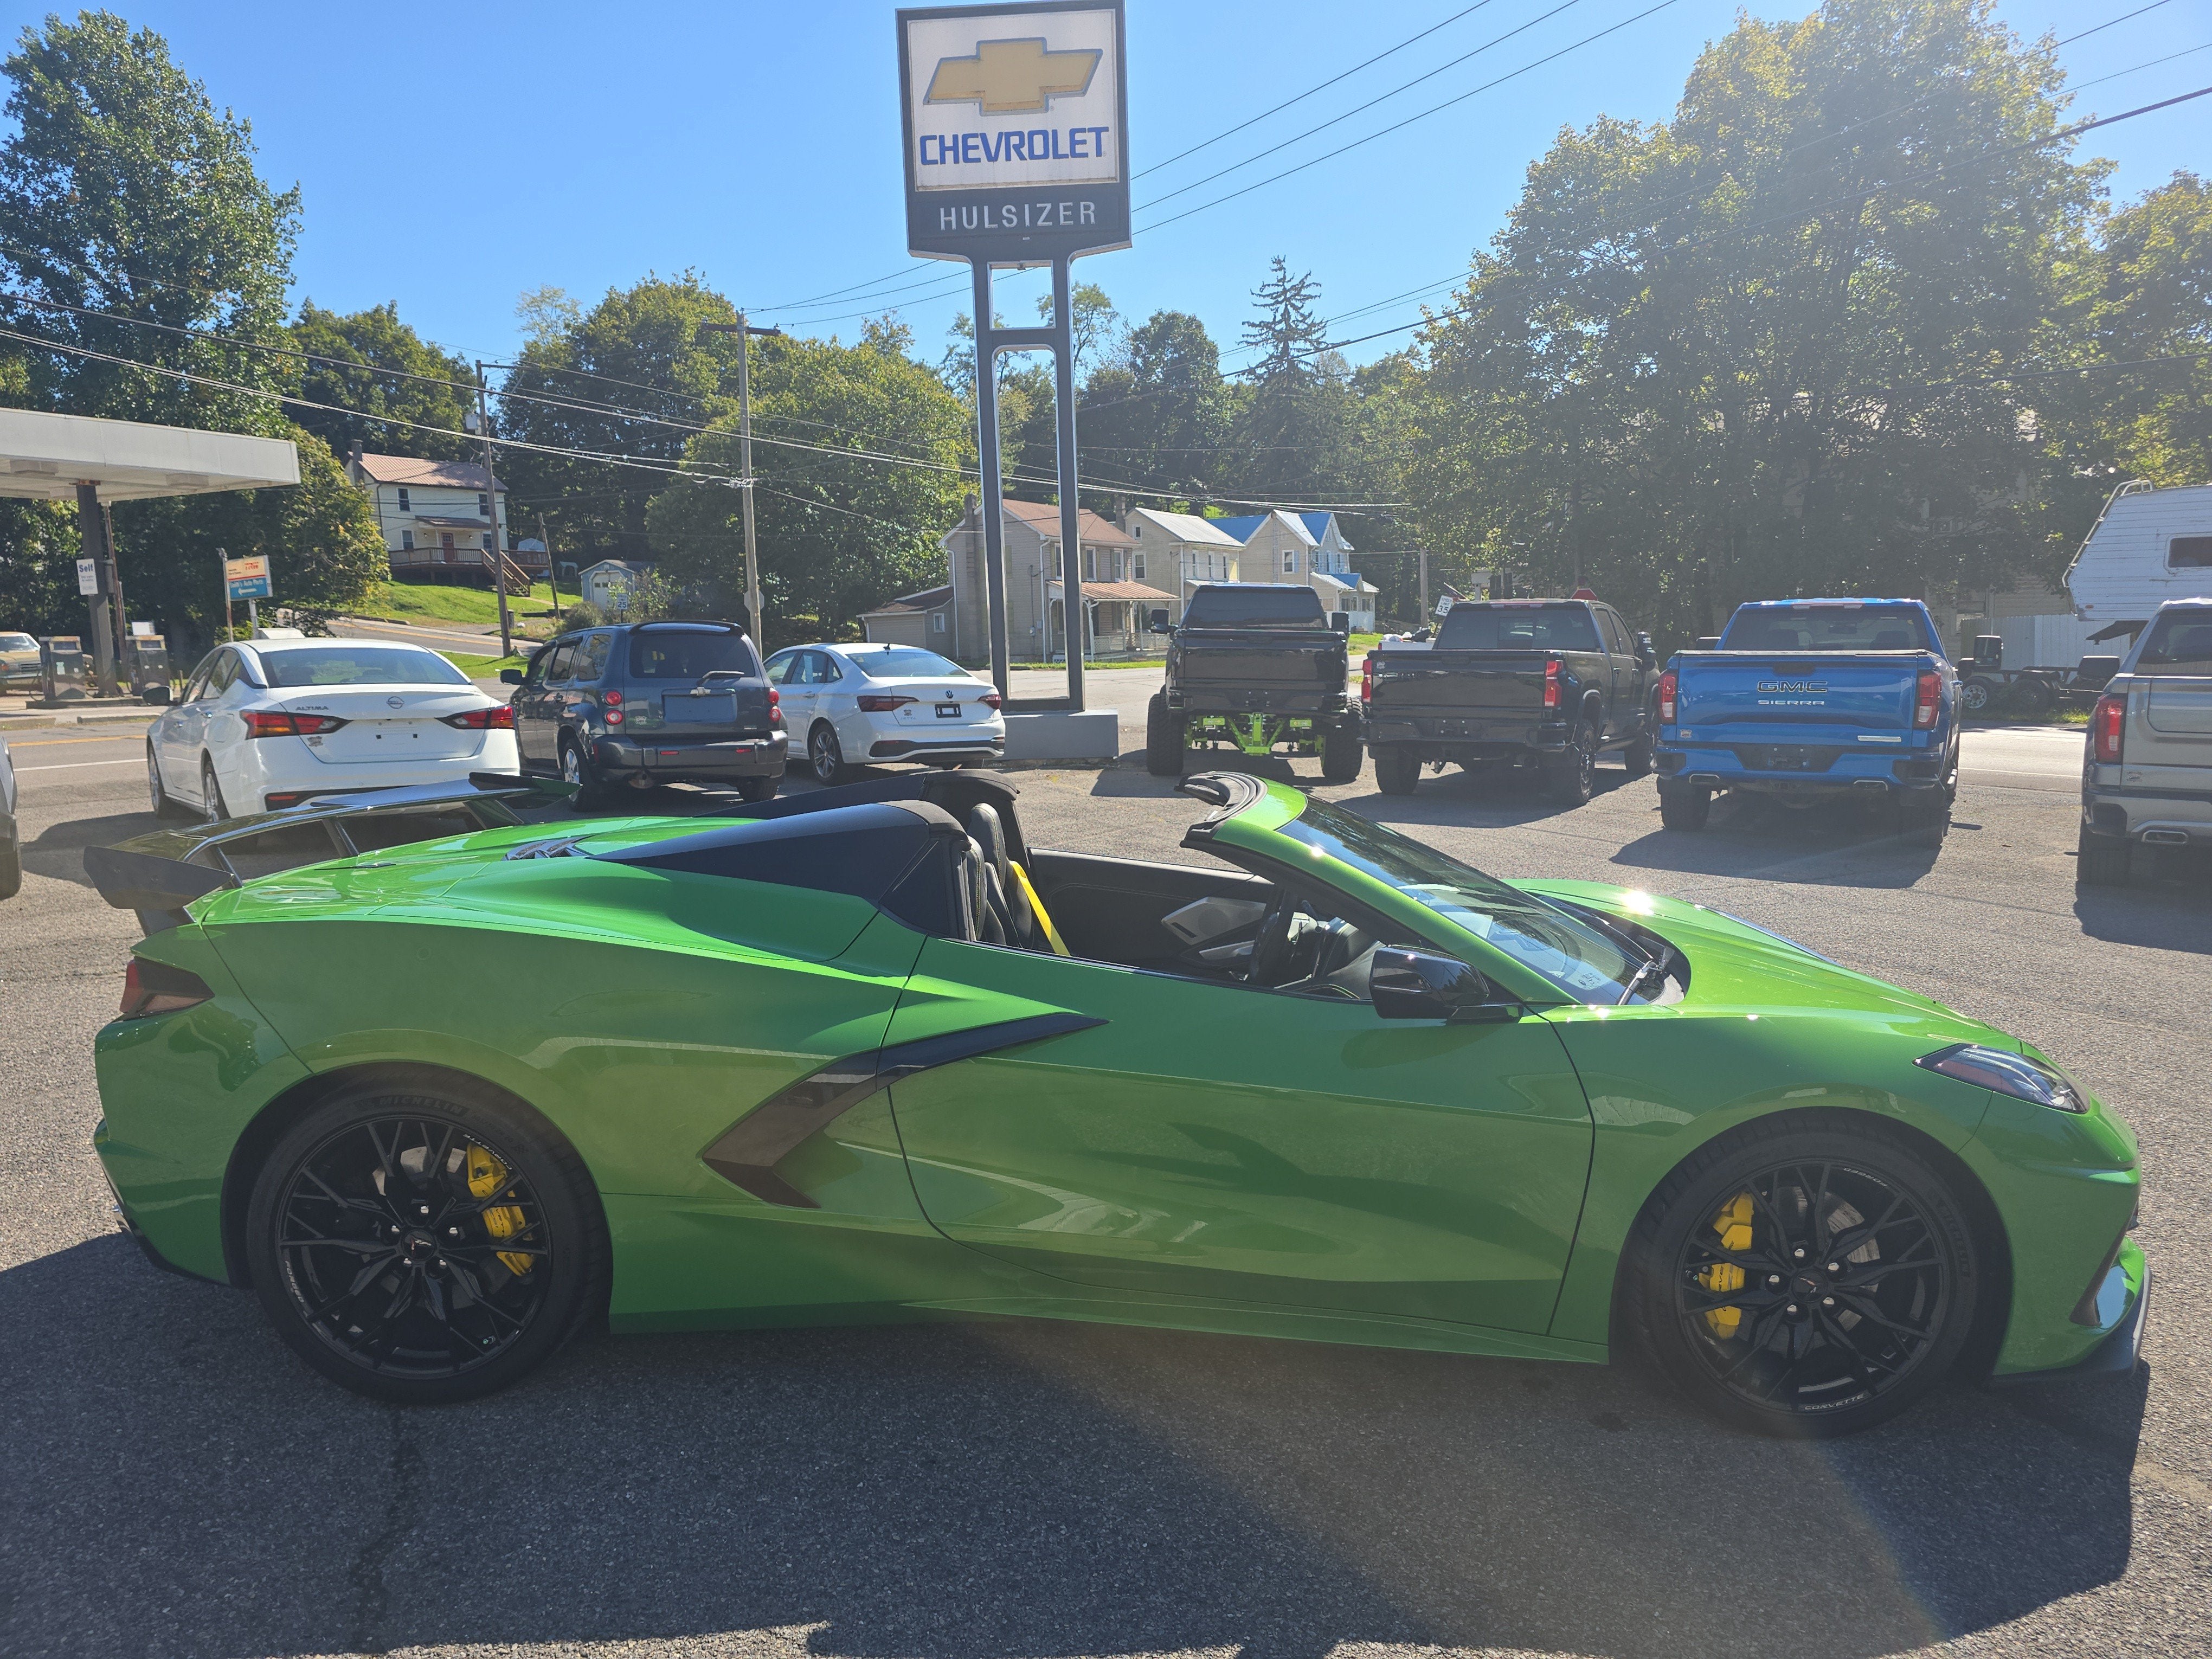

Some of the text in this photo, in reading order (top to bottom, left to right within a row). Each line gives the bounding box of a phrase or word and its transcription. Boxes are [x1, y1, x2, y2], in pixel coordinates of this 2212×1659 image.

[919, 126, 1109, 165] CHEVROLET
[940, 201, 1096, 231] HULSIZER
[79, 563, 93, 573] Self
[1437, 605, 1449, 614] 35
[1757, 680, 1828, 693] GMC
[379, 1096, 462, 1115] MICHELIN
[463, 1134, 512, 1171] CORVETTE
[1843, 1167, 1888, 1187] FORGED
[285, 1261, 305, 1303] FORGED
[1804, 1393, 1865, 1411] CORVETTE
